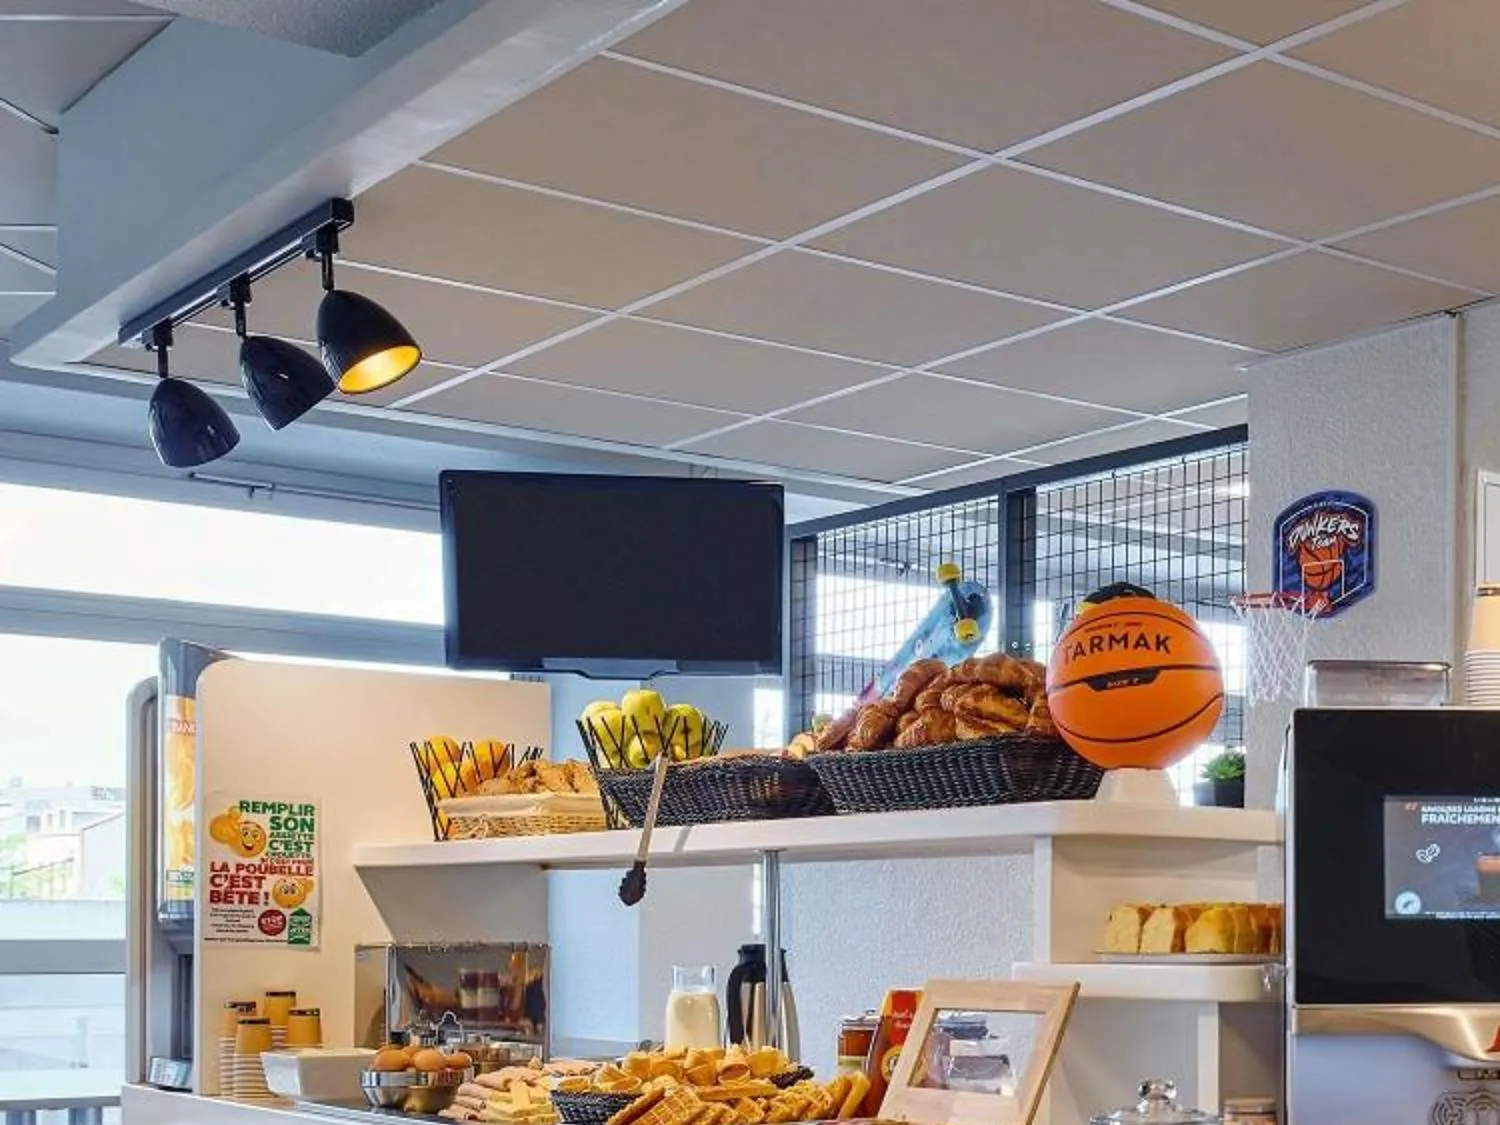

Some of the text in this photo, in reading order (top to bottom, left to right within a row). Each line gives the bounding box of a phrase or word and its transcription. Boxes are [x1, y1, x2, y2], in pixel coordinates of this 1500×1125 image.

[1063, 632, 1171, 664] TARMAK
[239, 800, 315, 816] REMPLIR
[269, 816, 315, 832] SON
[268, 840, 314, 852] C'EST
[210, 861, 314, 876] LA POUBELLE
[209, 874, 267, 889] C'EST
